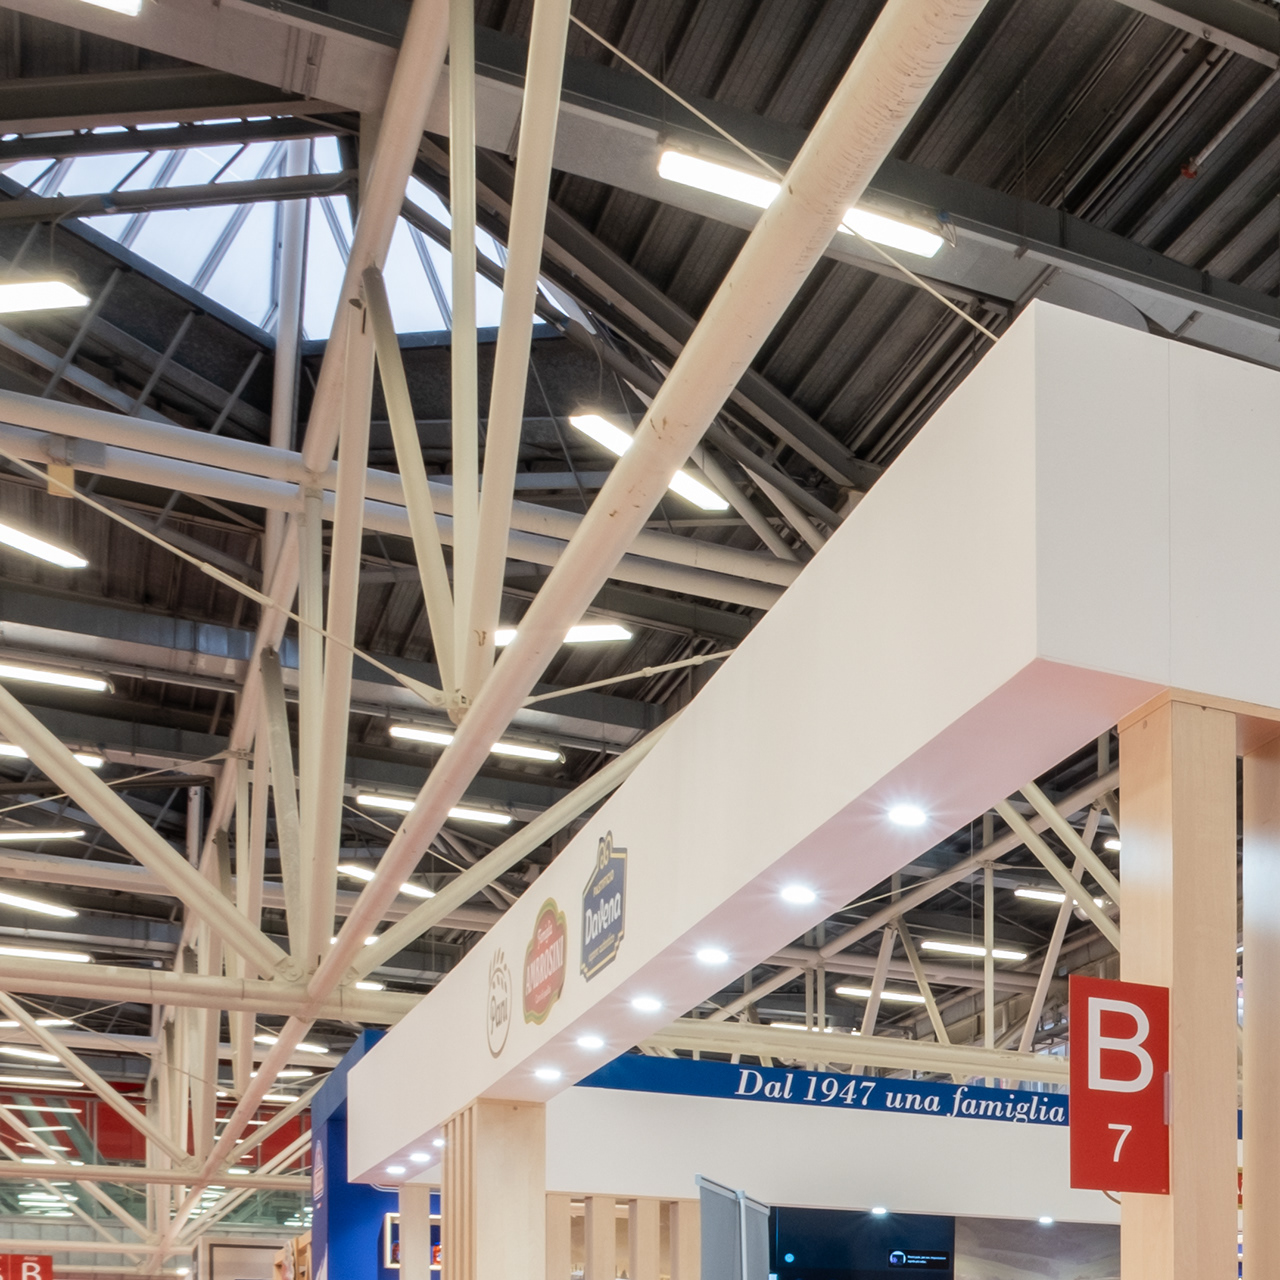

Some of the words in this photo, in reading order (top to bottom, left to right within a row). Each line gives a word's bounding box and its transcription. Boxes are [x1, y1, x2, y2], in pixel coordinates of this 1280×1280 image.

[585, 892, 621, 945] Davena
[525, 935, 564, 995] AMBROSINI
[1087, 996, 1154, 1094] B
[734, 1068, 793, 1100] Dal
[803, 1075, 876, 1106] 1947
[885, 1089, 942, 1113] una
[946, 1085, 1066, 1125] famiglia
[1108, 1123, 1132, 1162] 7
